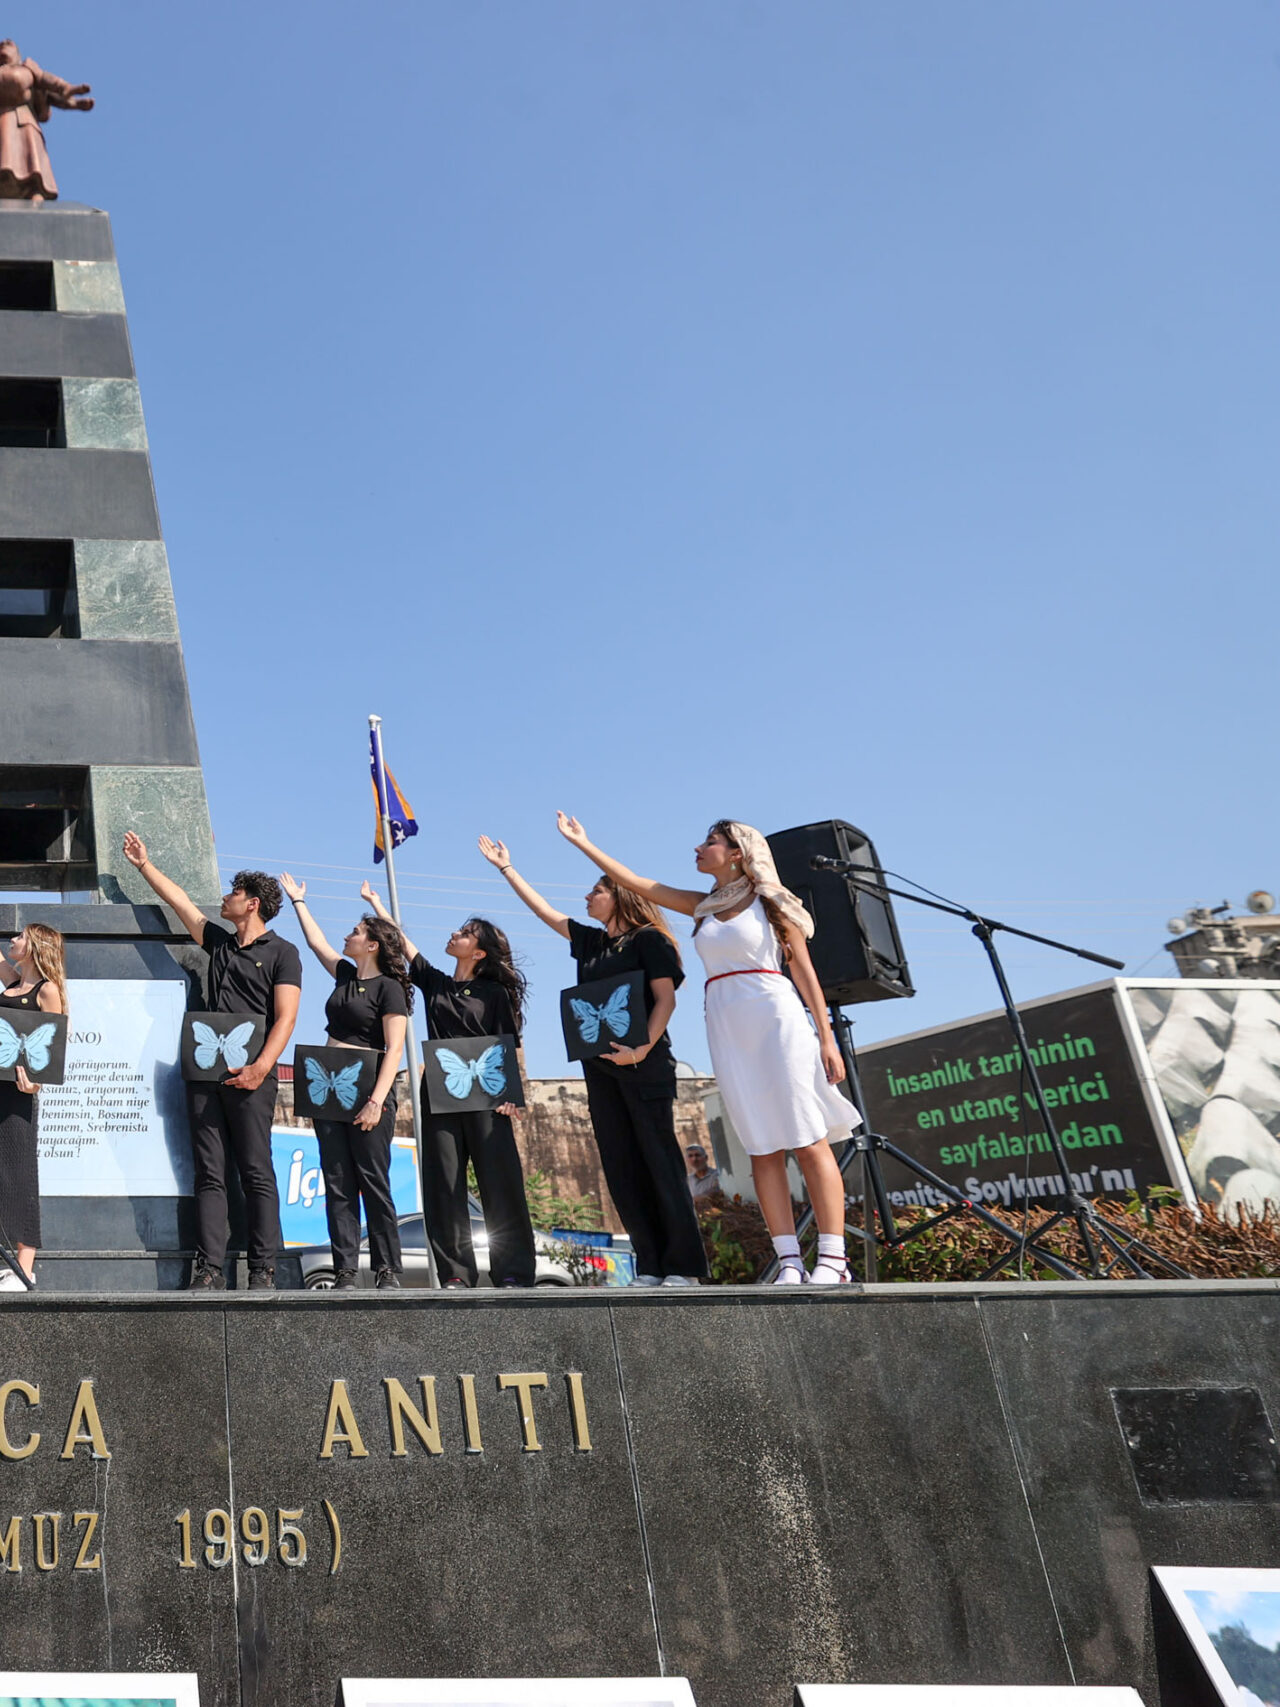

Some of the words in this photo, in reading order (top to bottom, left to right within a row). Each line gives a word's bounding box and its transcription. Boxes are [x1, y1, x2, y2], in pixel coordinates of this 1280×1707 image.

[68, 1059, 132, 1072] görüyorum.
[108, 1071, 145, 1082] devam
[887, 1057, 975, 1097] İnsanlık
[43, 1098, 84, 1108] annem,
[86, 1097, 124, 1107] babam
[917, 1109, 946, 1130] en
[949, 1094, 1020, 1123] utanç
[1023, 1071, 1111, 1111] verici
[42, 1109, 94, 1120] benimsin,
[97, 1110, 144, 1121] Bosnam,
[42, 1123, 84, 1134] annem,
[44, 1147, 74, 1158] olsun
[319, 1372, 593, 1459] ANITI
[175, 1499, 342, 1576] 1995)
